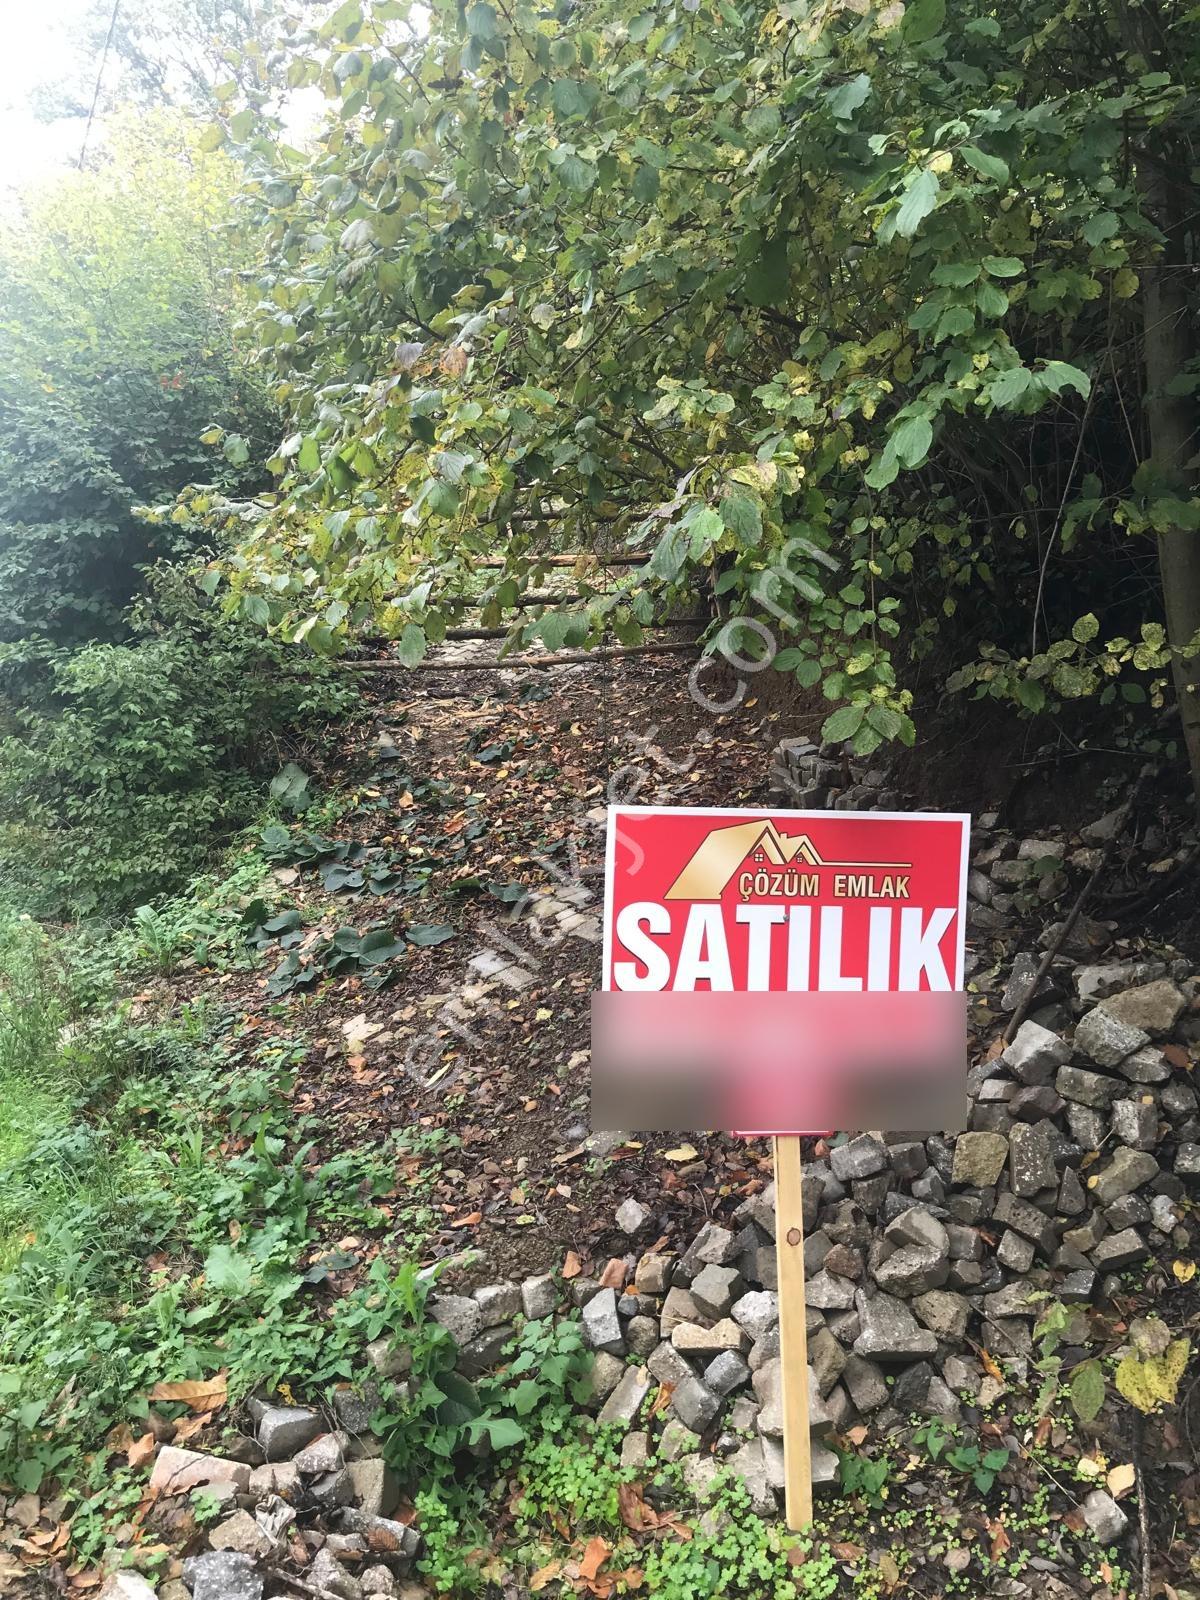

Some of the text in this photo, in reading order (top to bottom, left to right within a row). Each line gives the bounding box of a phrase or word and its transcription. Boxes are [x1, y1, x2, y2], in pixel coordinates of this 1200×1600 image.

[738, 867, 912, 902] ÇÖZÜM EMLAK
[613, 901, 958, 992] SATILIK
